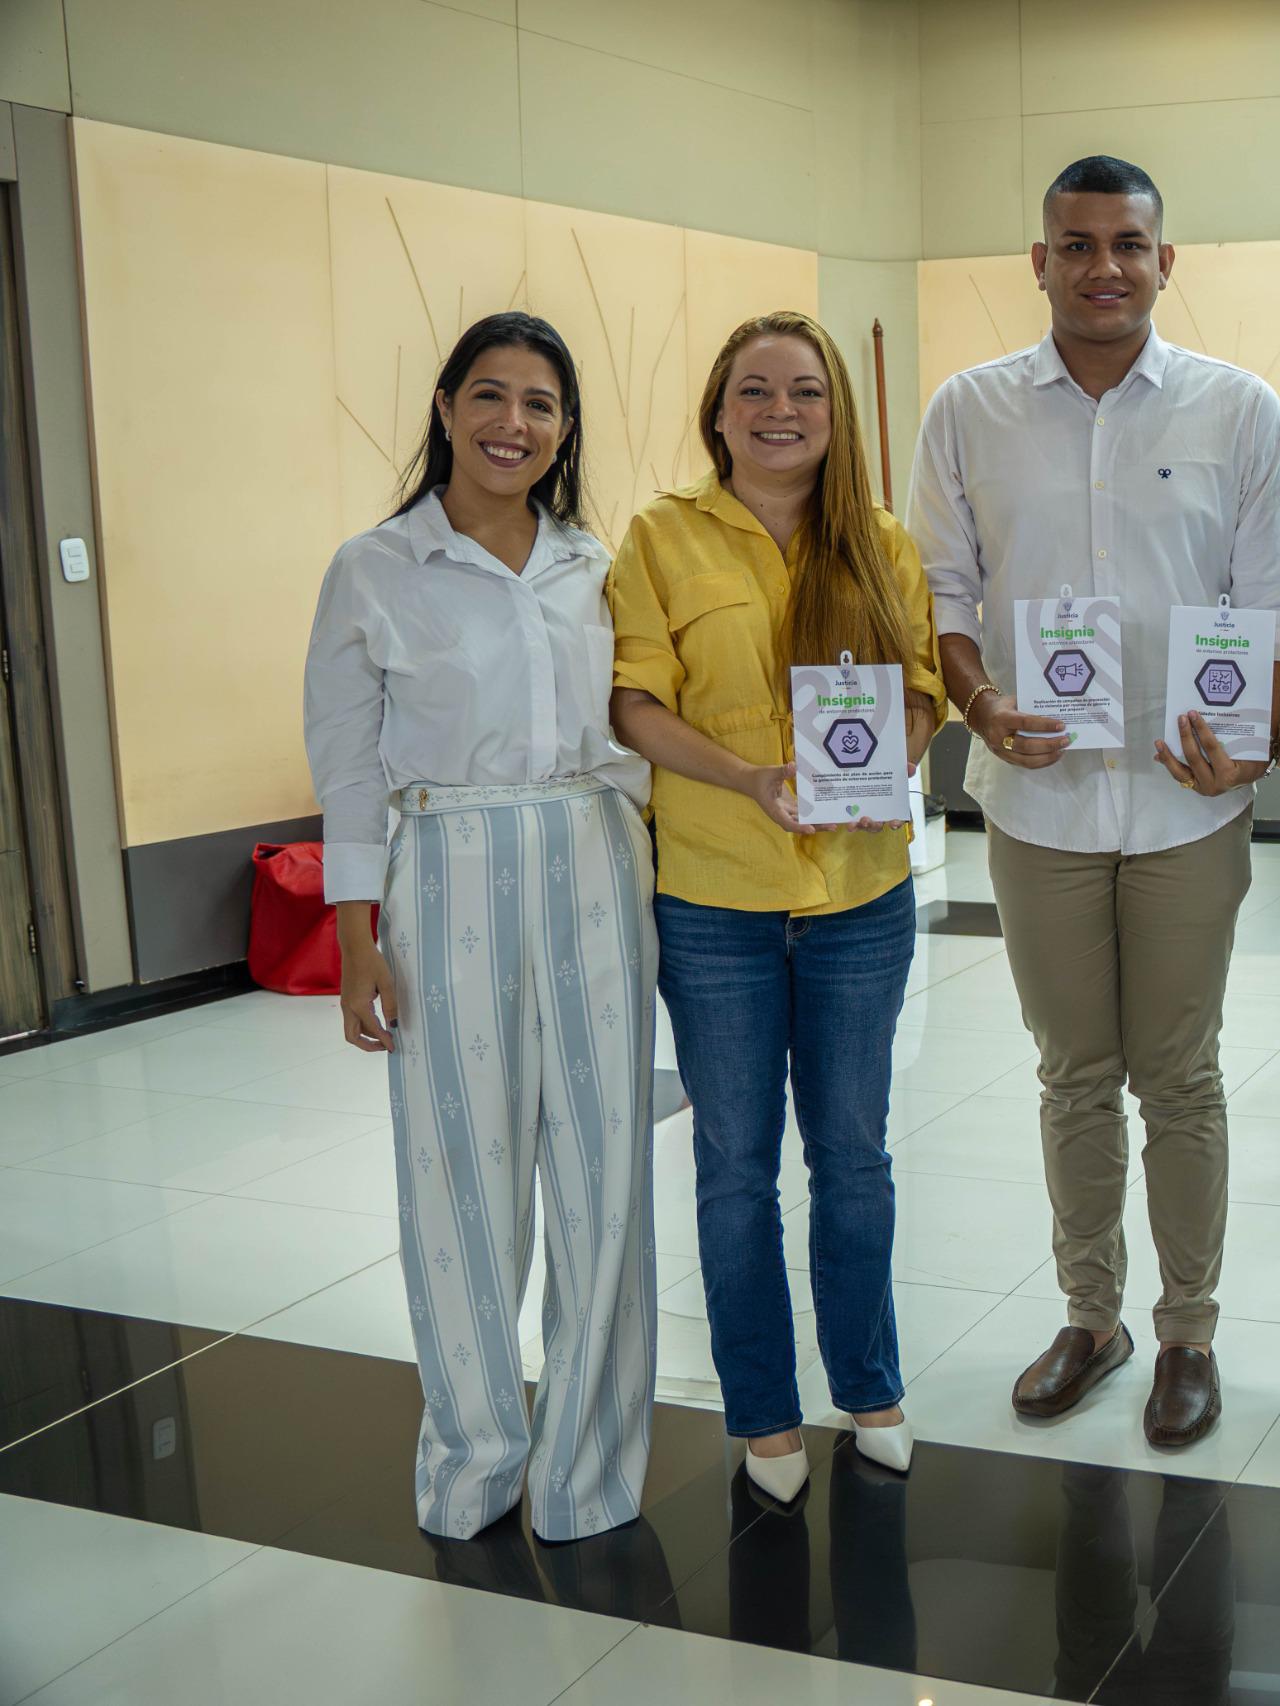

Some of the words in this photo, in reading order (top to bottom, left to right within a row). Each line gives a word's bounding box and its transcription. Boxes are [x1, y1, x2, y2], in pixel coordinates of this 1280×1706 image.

[1040, 625, 1095, 640] Insignia
[1195, 634, 1250, 649] Insignia
[817, 693, 875, 708] Insignia
